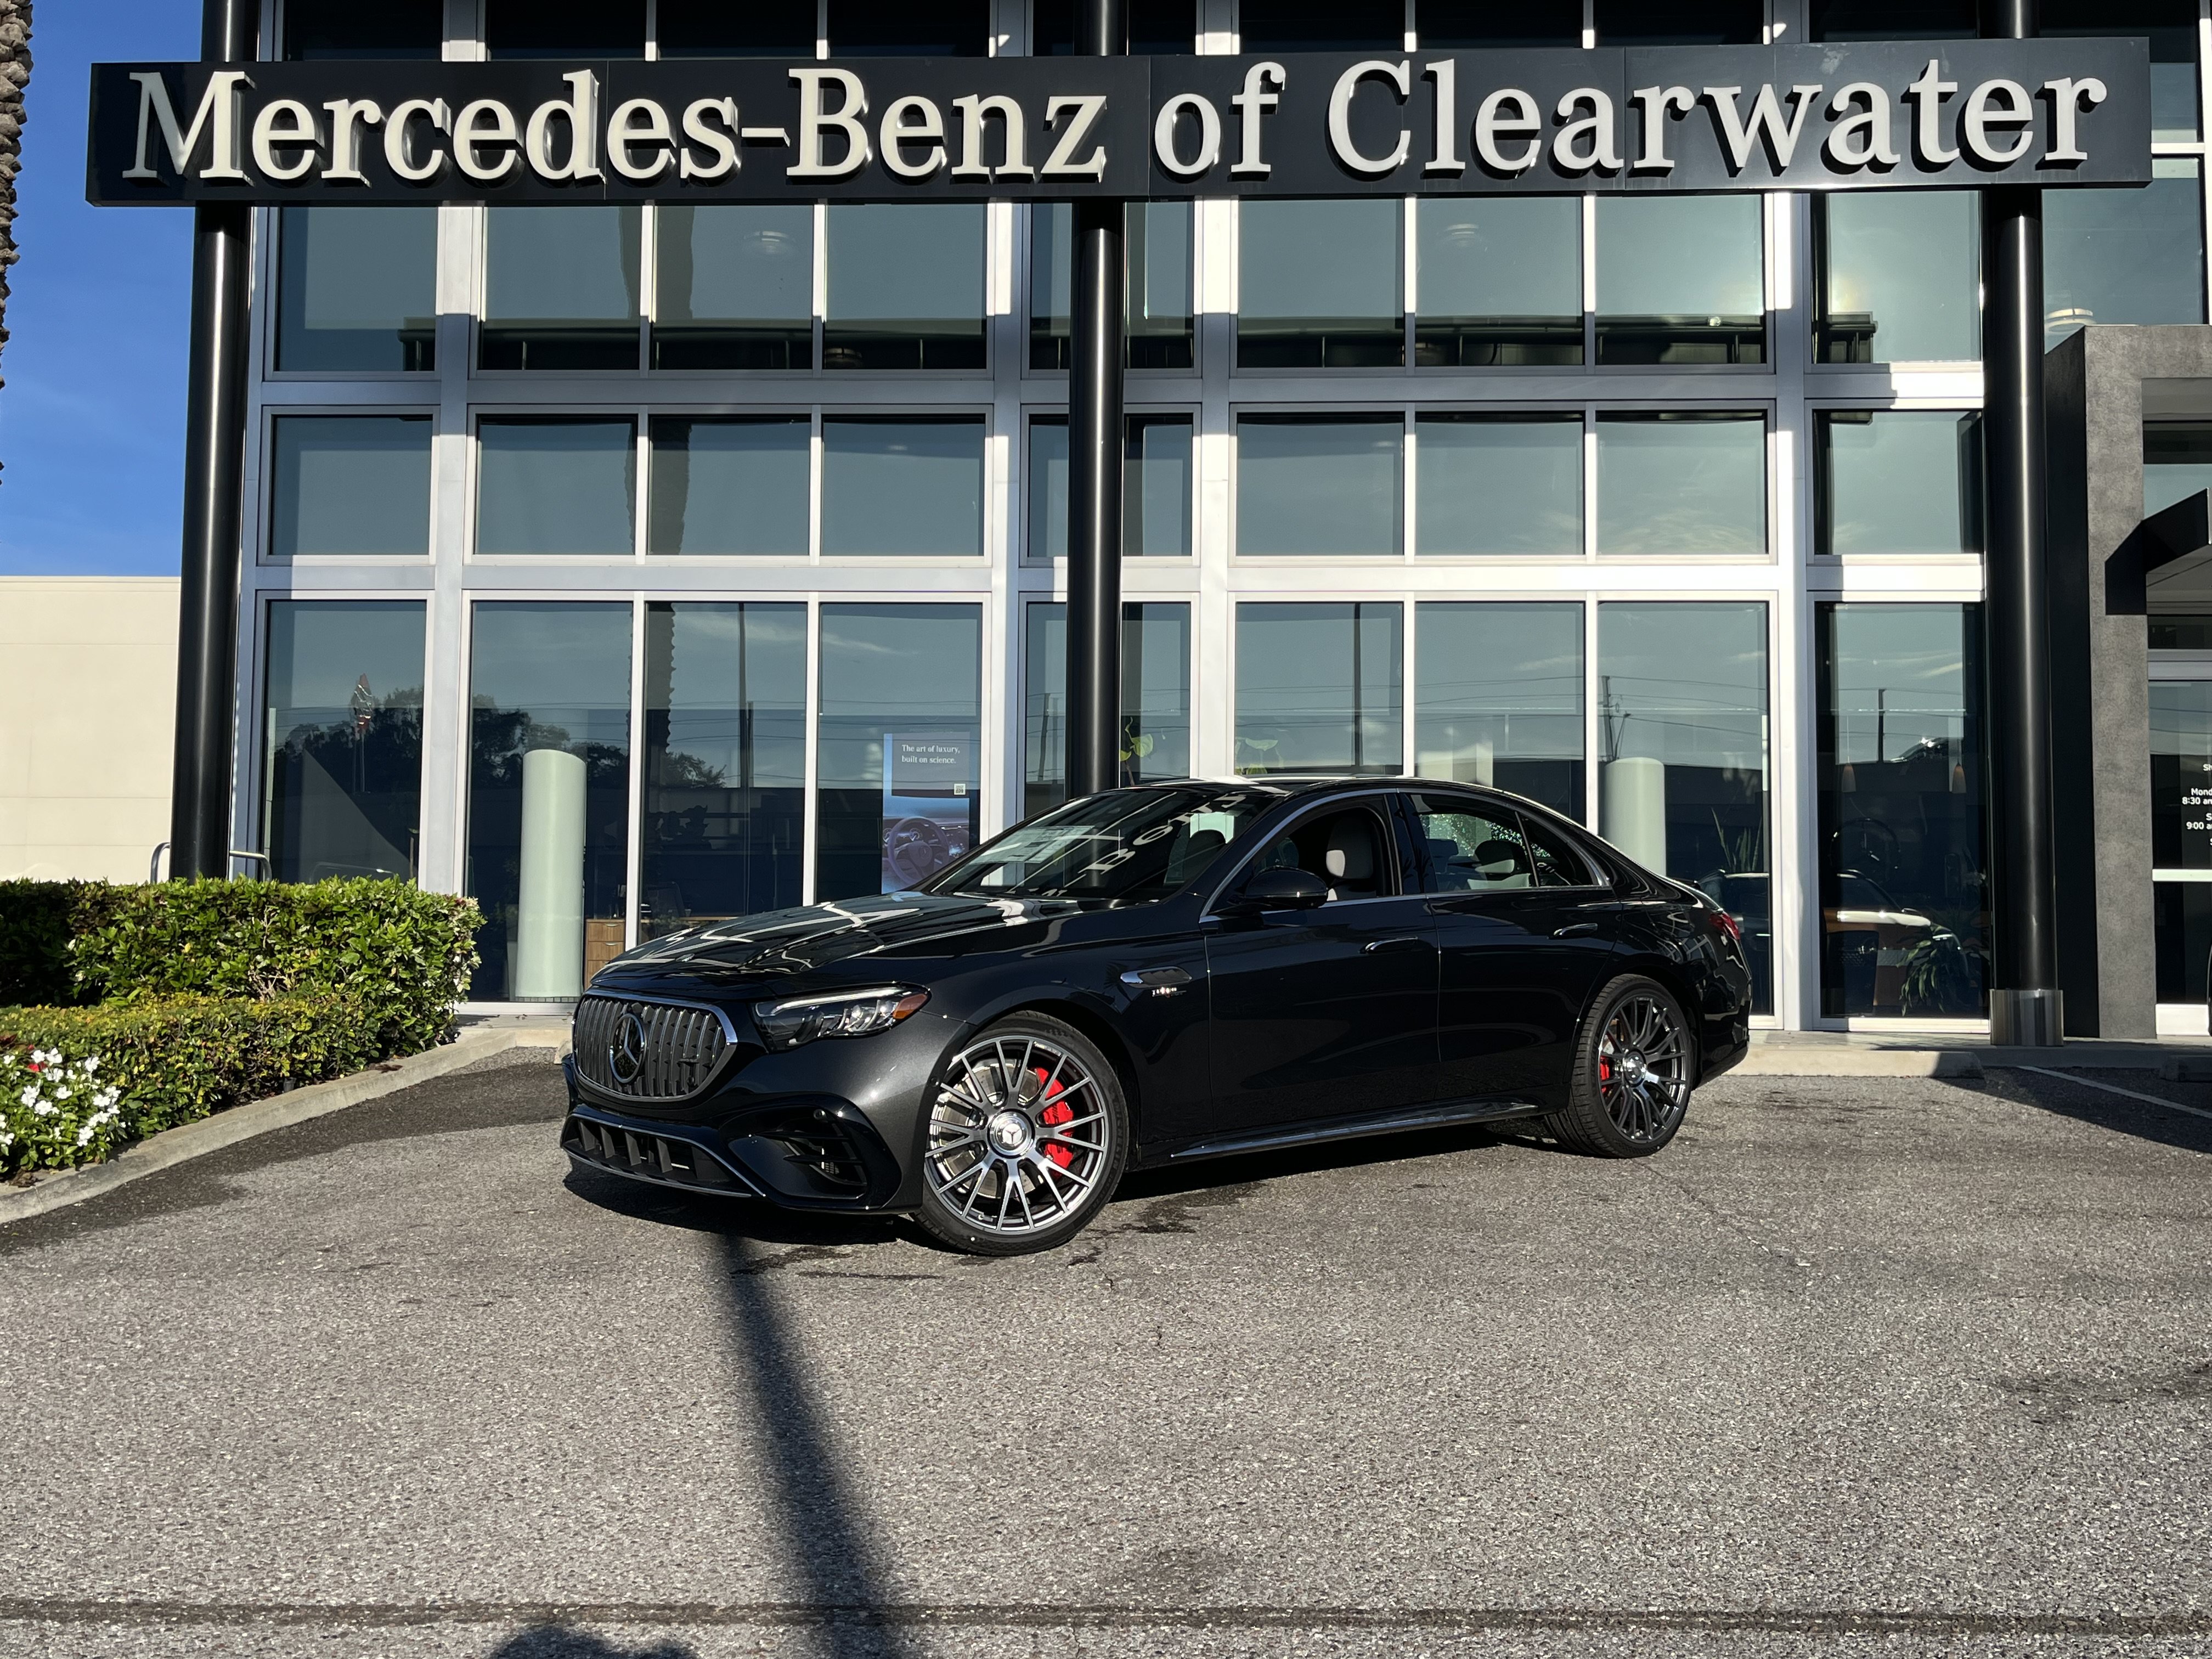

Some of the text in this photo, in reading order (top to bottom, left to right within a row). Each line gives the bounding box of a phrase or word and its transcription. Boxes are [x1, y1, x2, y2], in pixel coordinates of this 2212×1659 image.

[122, 58, 2108, 184] Mercedes-Benz of Clearwater
[936, 745, 961, 754] luxury,
[2182, 797, 2200, 805] 8:30
[2186, 821, 2204, 830] 9:00
